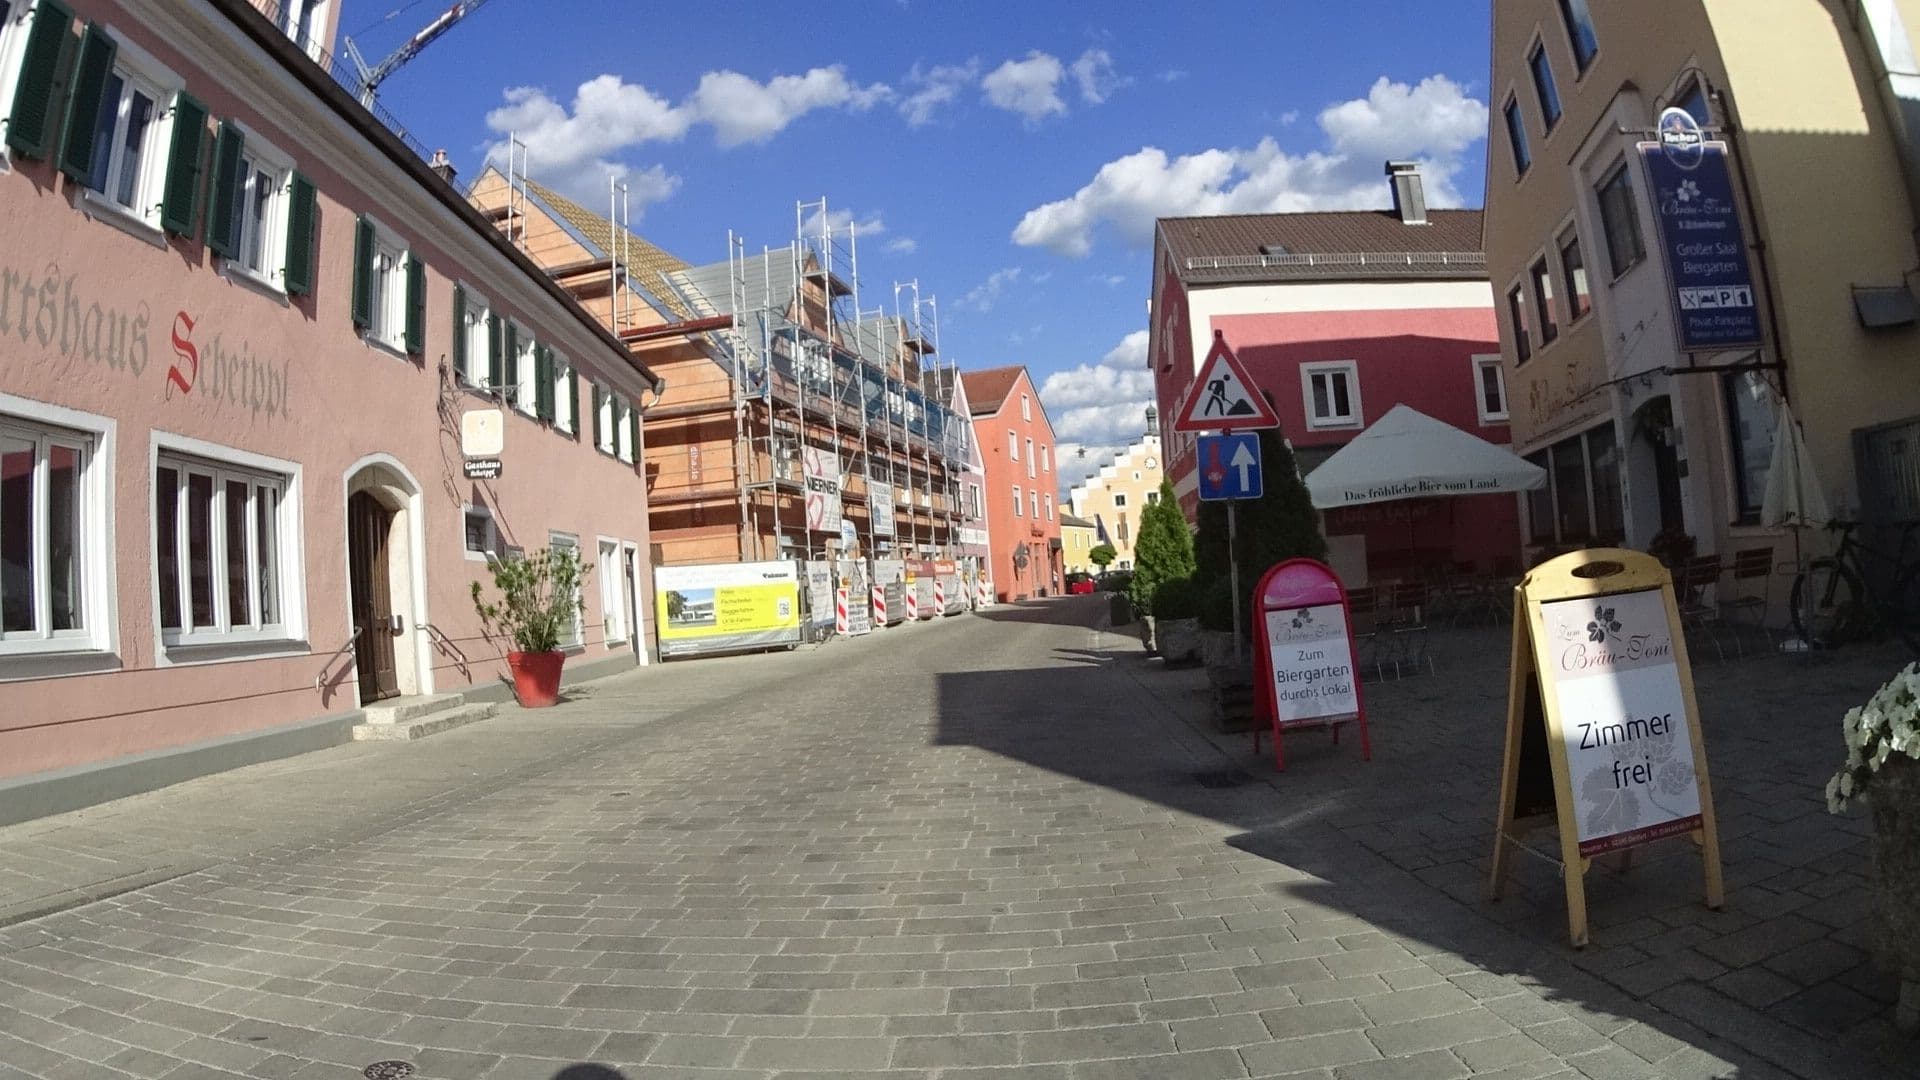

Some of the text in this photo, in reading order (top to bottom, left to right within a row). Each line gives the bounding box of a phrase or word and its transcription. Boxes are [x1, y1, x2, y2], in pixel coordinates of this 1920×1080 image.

[1676, 242, 1738, 256] Großer Saal
[1683, 262, 1739, 276] Biergarten
[166, 310, 290, 424] Scheippl
[1345, 478, 1500, 501] Das fröhliche Bier vom Land.
[1558, 624, 1581, 640] Zum
[1298, 650, 1324, 662] Zum
[1561, 634, 1670, 672] Bräu-Toni
[1277, 665, 1349, 684] Biergarten
[1280, 683, 1351, 700] durchs Lokal
[1578, 713, 1671, 750] Zimmer
[1612, 756, 1652, 789] frei
